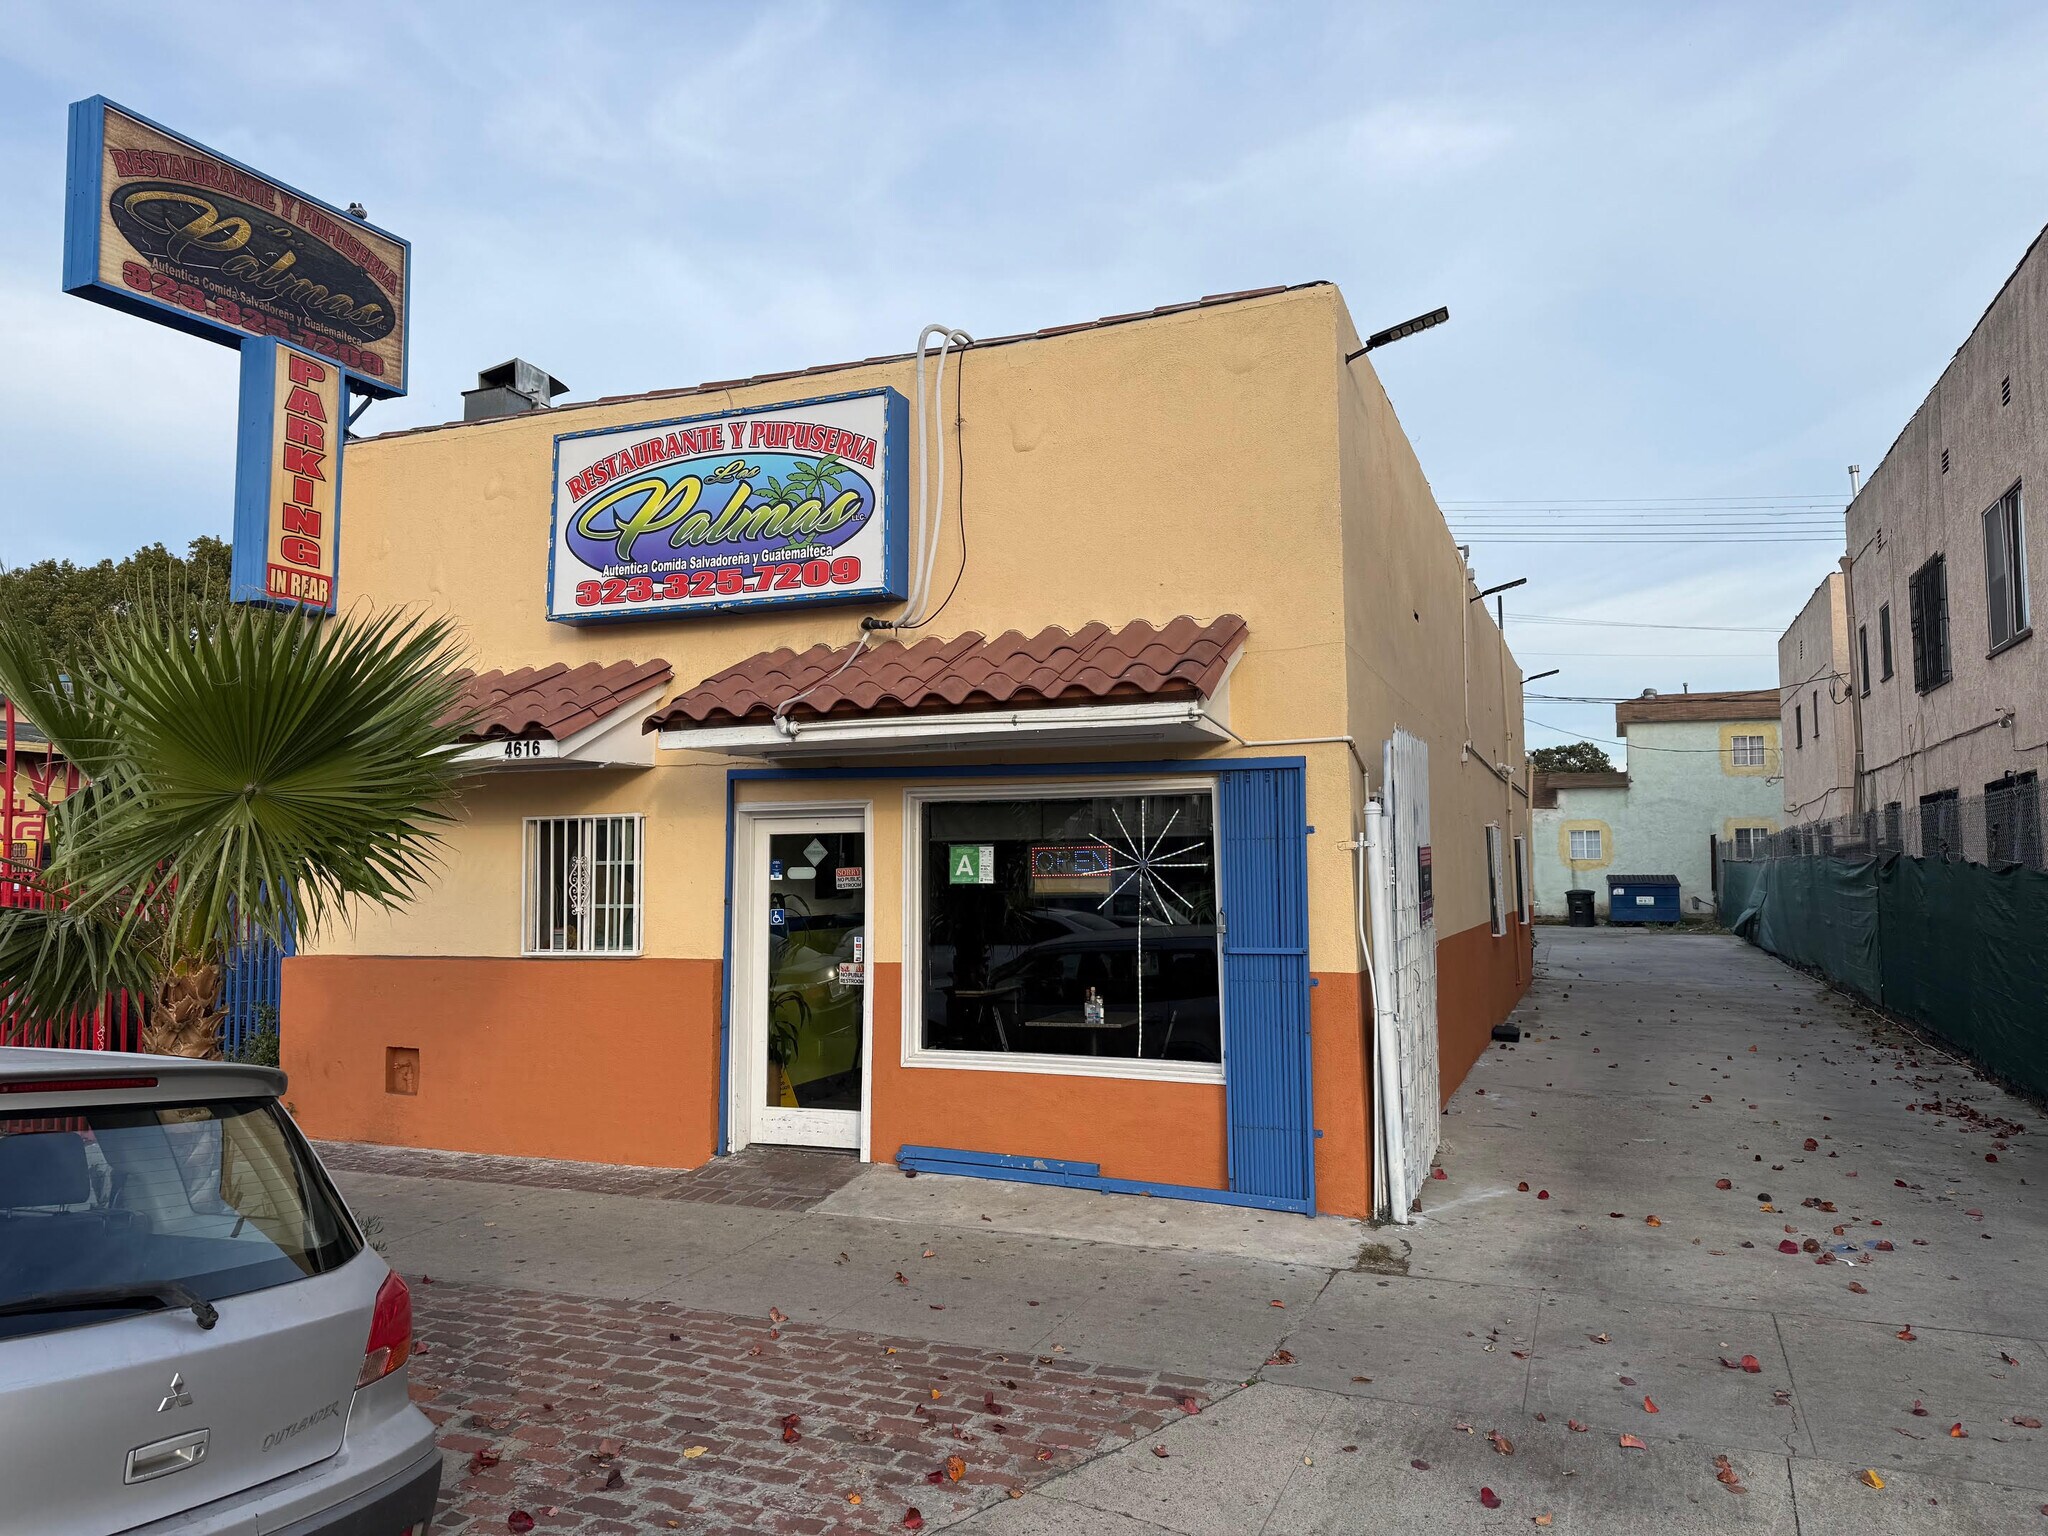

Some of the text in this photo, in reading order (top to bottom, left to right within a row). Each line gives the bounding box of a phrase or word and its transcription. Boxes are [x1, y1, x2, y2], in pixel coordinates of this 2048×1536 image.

[109, 148, 397, 295] RESTAURANTE Y PUPUSERIA
[124, 190, 385, 326] Palmas
[151, 257, 363, 347] Autentica Comida Salvadoreña y Guatemalteca
[281, 353, 328, 569] PARKING
[565, 421, 877, 503] RESTAURANTE Y PUPUSERIA
[703, 459, 761, 484] Las
[577, 474, 865, 561] Palmas
[270, 567, 329, 603] IN REAR
[575, 556, 861, 606] 323.325.7209
[602, 545, 833, 578] Autentica Comida Salvadoreña y Guatemalteca
[504, 740, 541, 758] 4616
[837, 868, 861, 876] SORRY
[955, 854, 974, 876] A
[1035, 850, 1108, 873] OPEN
[261, 1400, 339, 1452] OUTLANDER
